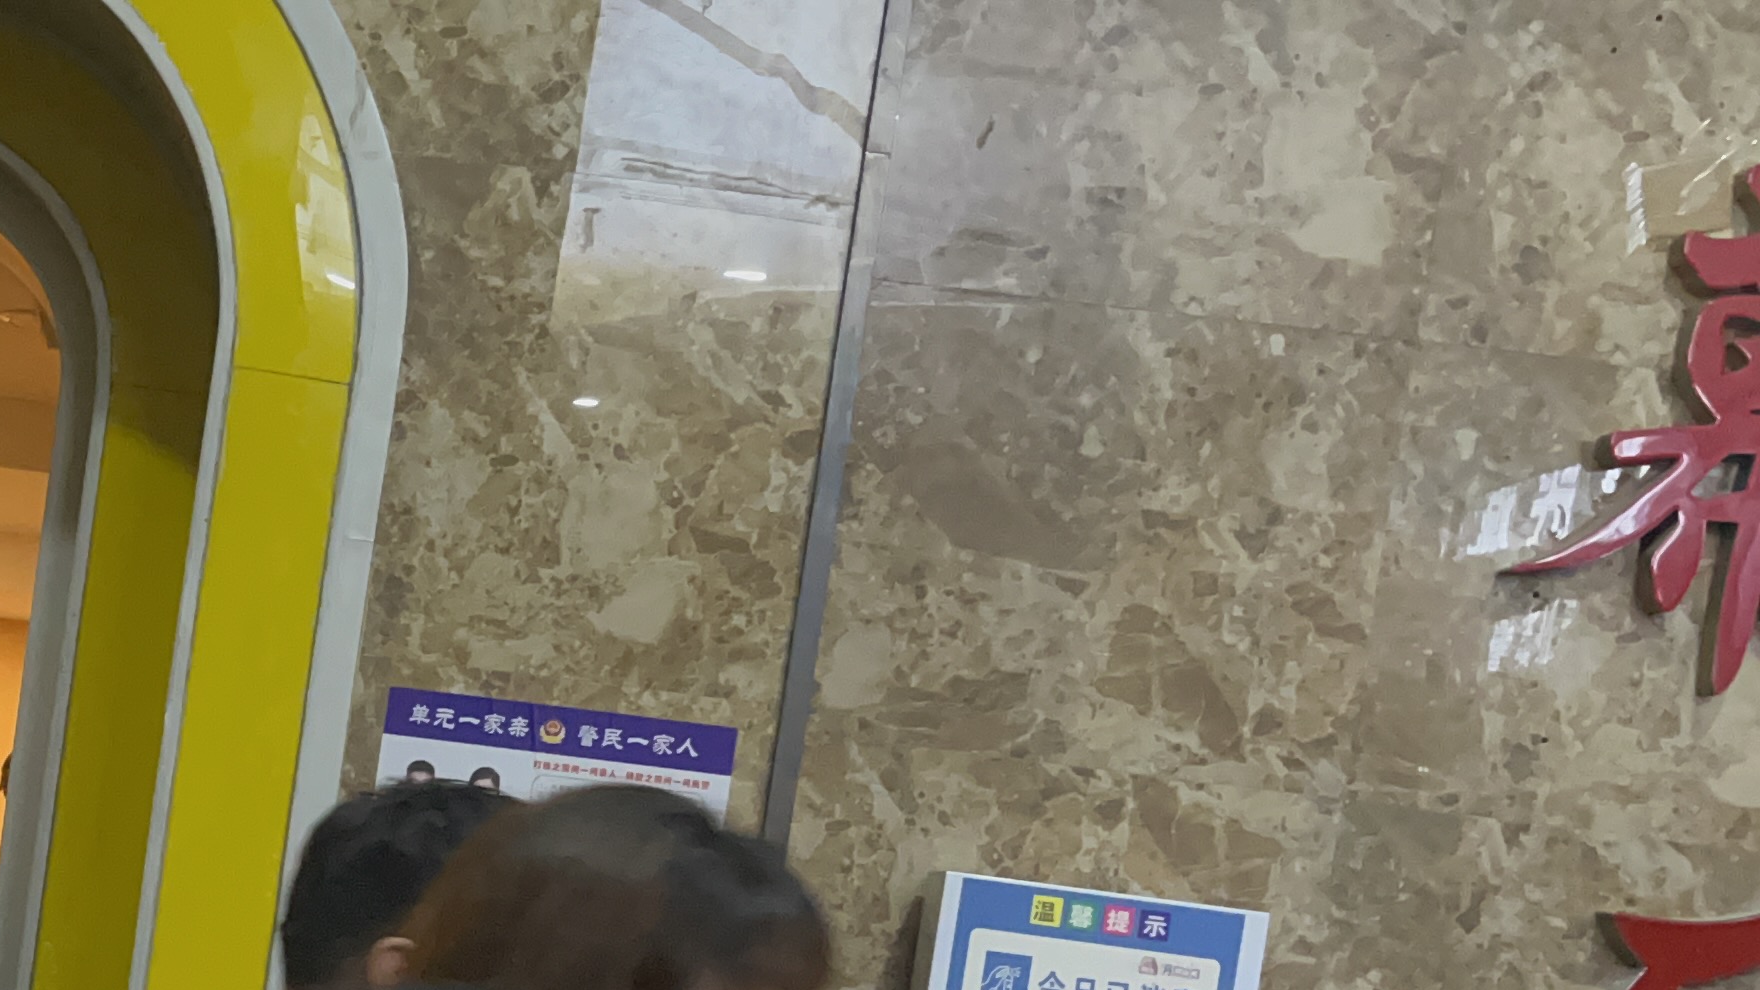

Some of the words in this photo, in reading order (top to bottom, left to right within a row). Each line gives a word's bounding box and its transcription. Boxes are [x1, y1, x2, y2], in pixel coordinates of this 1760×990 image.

[408, 703, 530, 738] 单元一家亲
[577, 725, 699, 758] 警民一家人
[1033, 900, 1167, 937] 温馨提示
